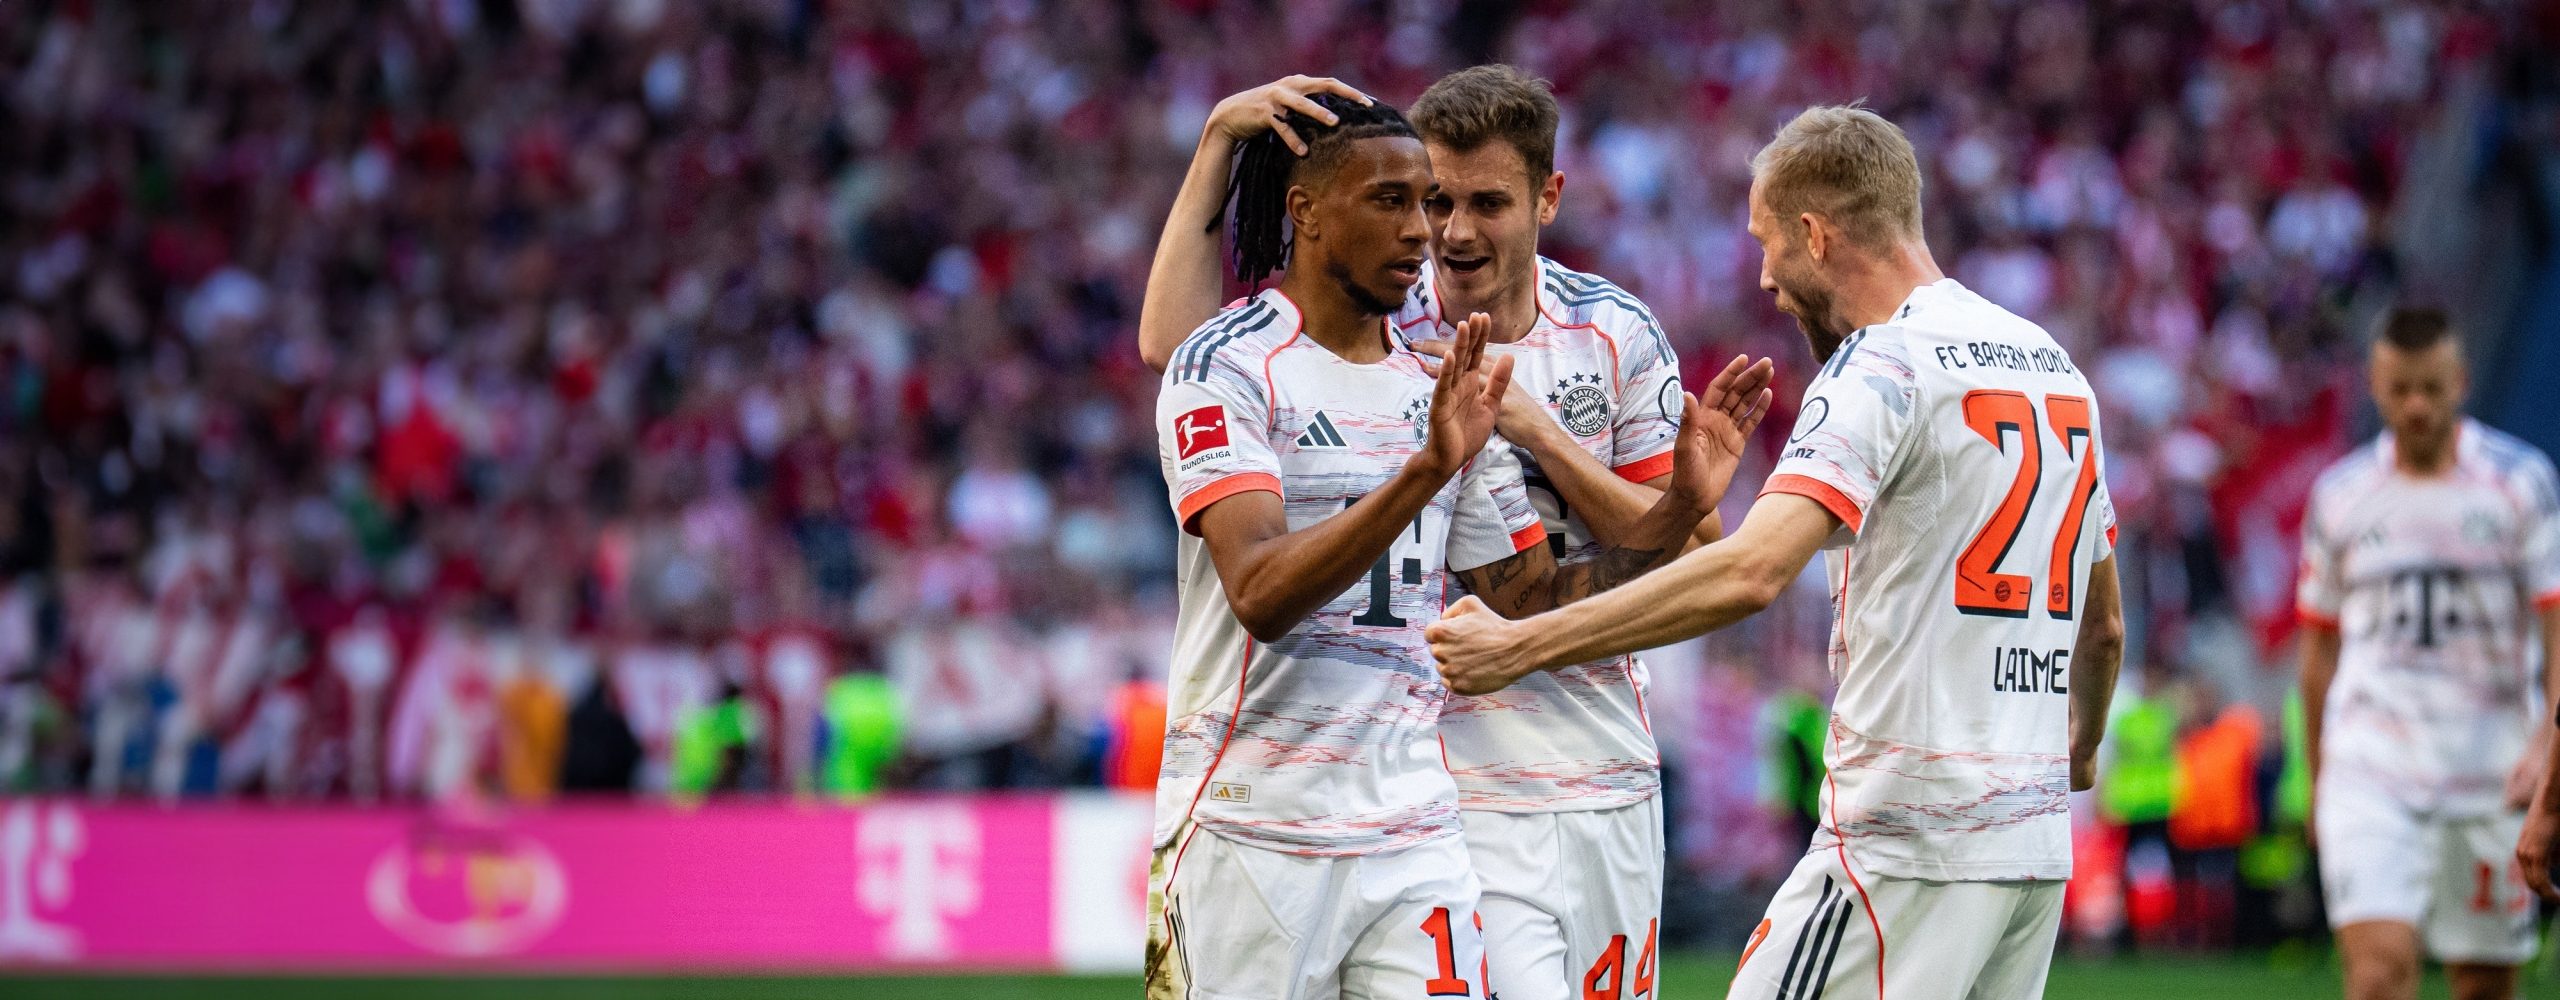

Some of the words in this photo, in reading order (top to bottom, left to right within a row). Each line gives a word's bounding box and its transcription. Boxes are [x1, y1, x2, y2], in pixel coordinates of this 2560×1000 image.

[1935, 345, 1967, 369] FC
[1967, 341, 2031, 372] BAYERN
[2029, 346, 2077, 376] MÜNC
[1564, 398, 1573, 411] FC
[1571, 389, 1605, 406] BAYERN
[1181, 450, 1232, 472] BUNDESLIGA
[1955, 389, 2098, 621] 27
[1583, 916, 1657, 1000] 44
